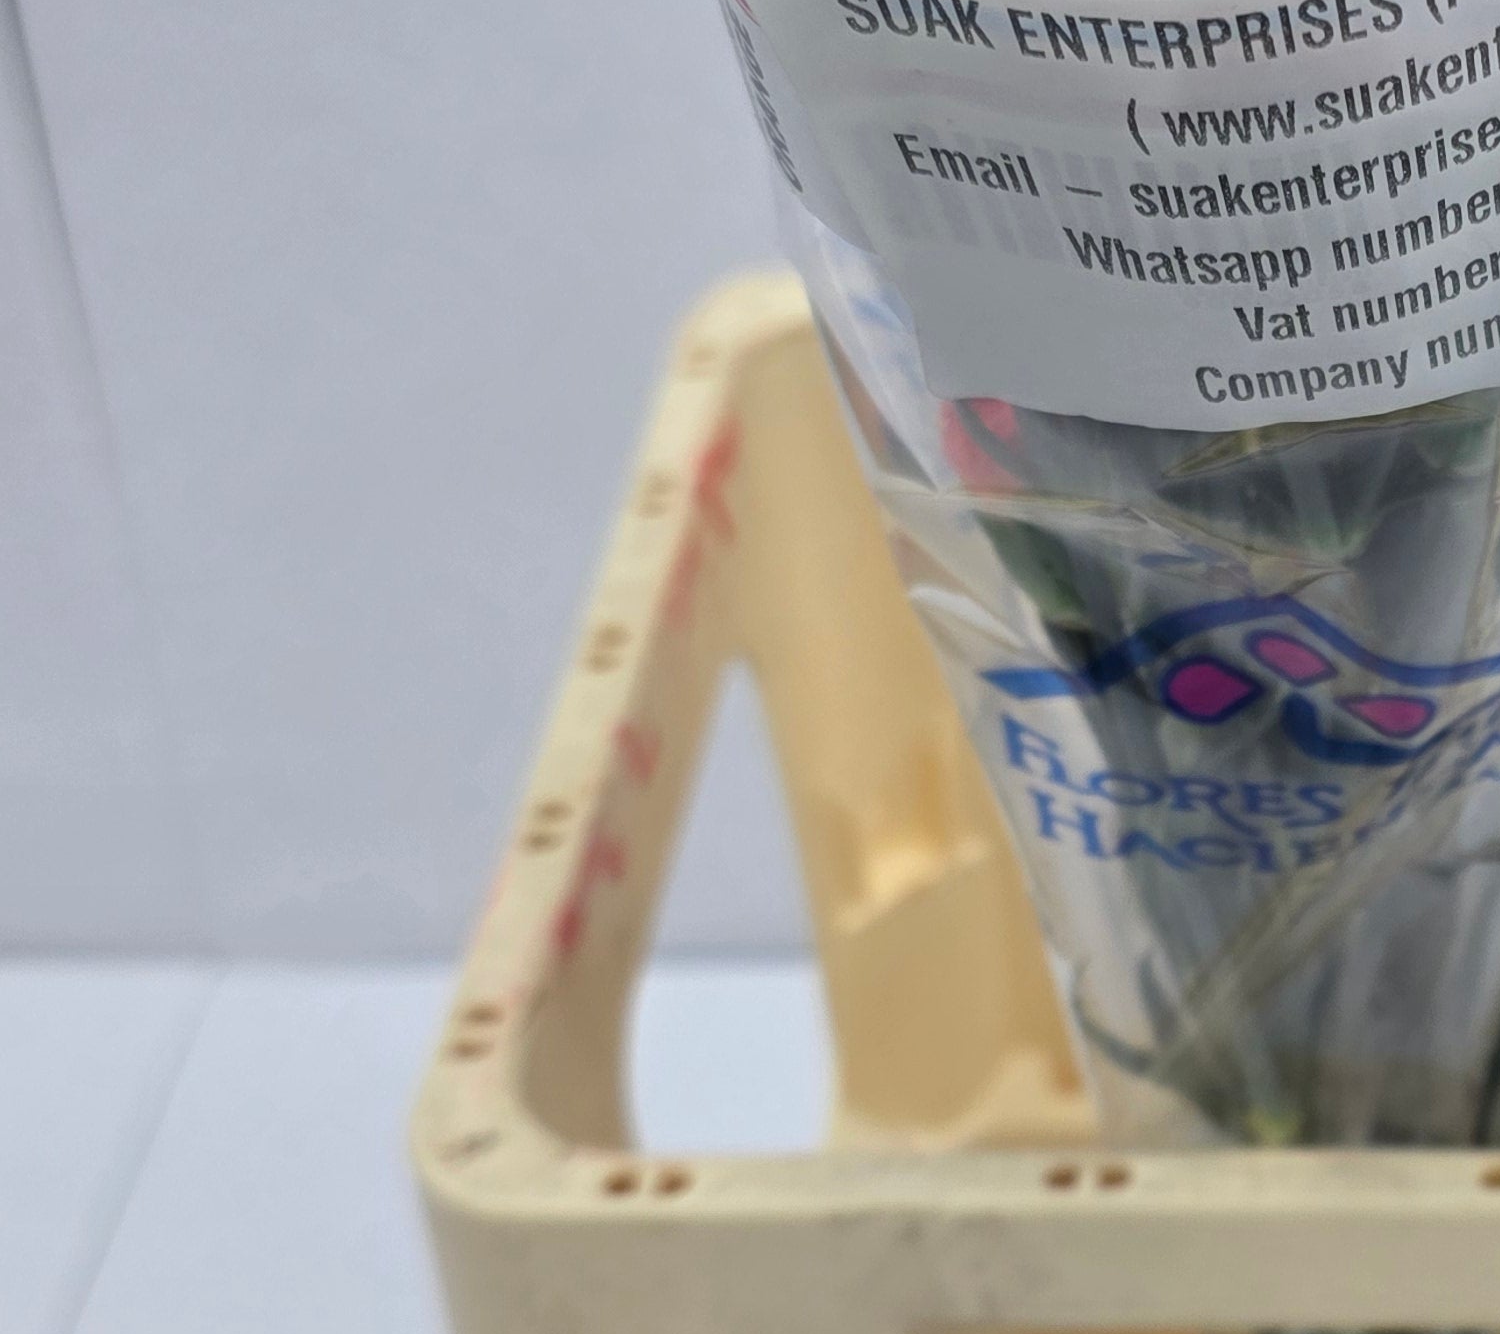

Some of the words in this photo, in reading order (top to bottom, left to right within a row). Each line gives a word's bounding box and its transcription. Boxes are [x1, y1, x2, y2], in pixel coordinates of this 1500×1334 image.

[893, 132, 1041, 198] Email
[1063, 225, 1313, 292] Whatsapp
[1233, 301, 1315, 344] Vat
[1194, 348, 1409, 405] Company
